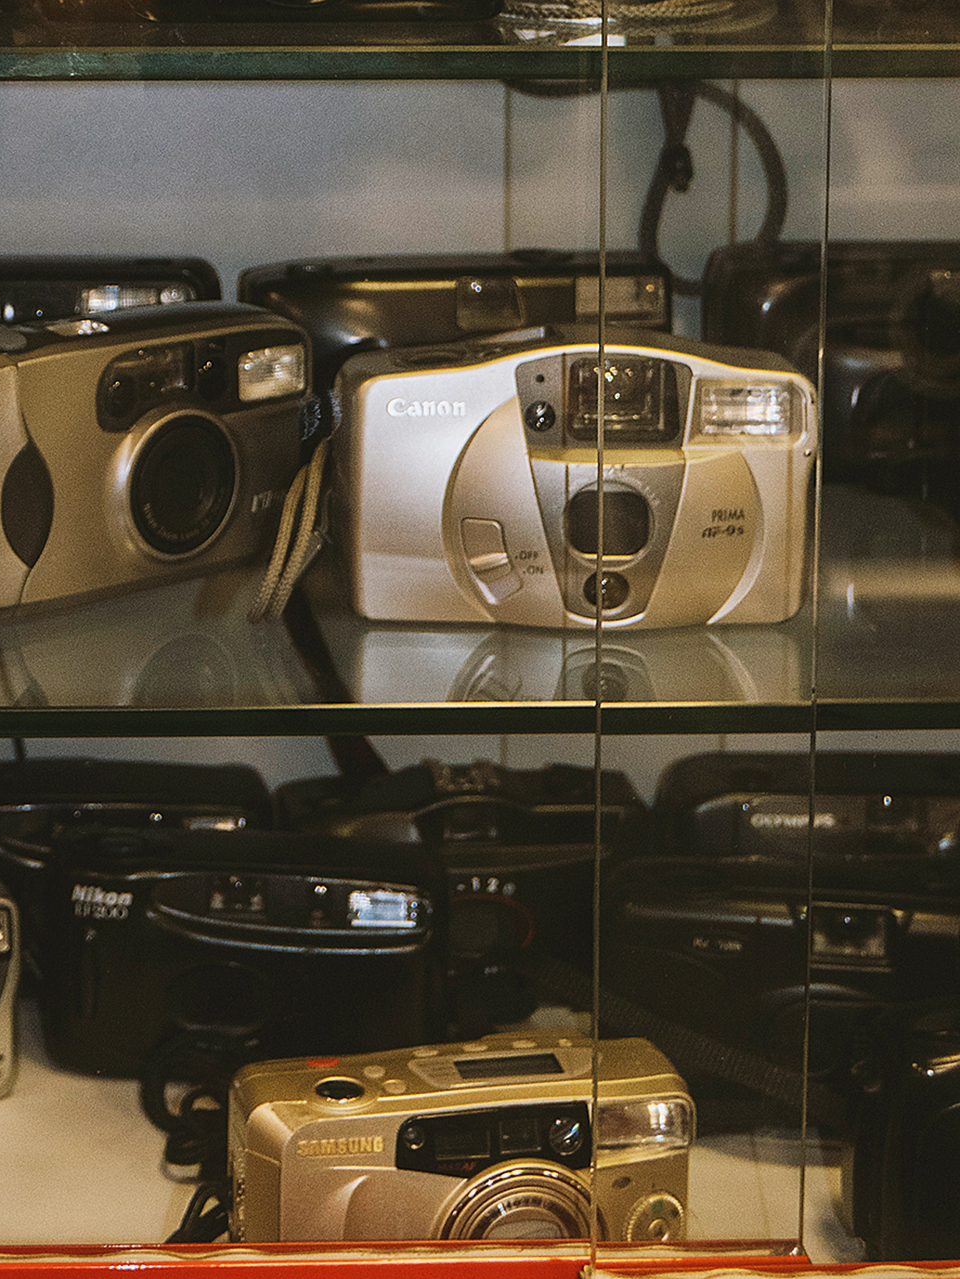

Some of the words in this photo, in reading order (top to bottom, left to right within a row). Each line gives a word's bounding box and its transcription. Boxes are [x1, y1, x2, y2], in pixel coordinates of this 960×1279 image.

[386, 398, 466, 417] Canon
[711, 509, 746, 522] PRIMA
[72, 884, 134, 906] Nikon
[297, 1136, 384, 1156] SAMSUNG
